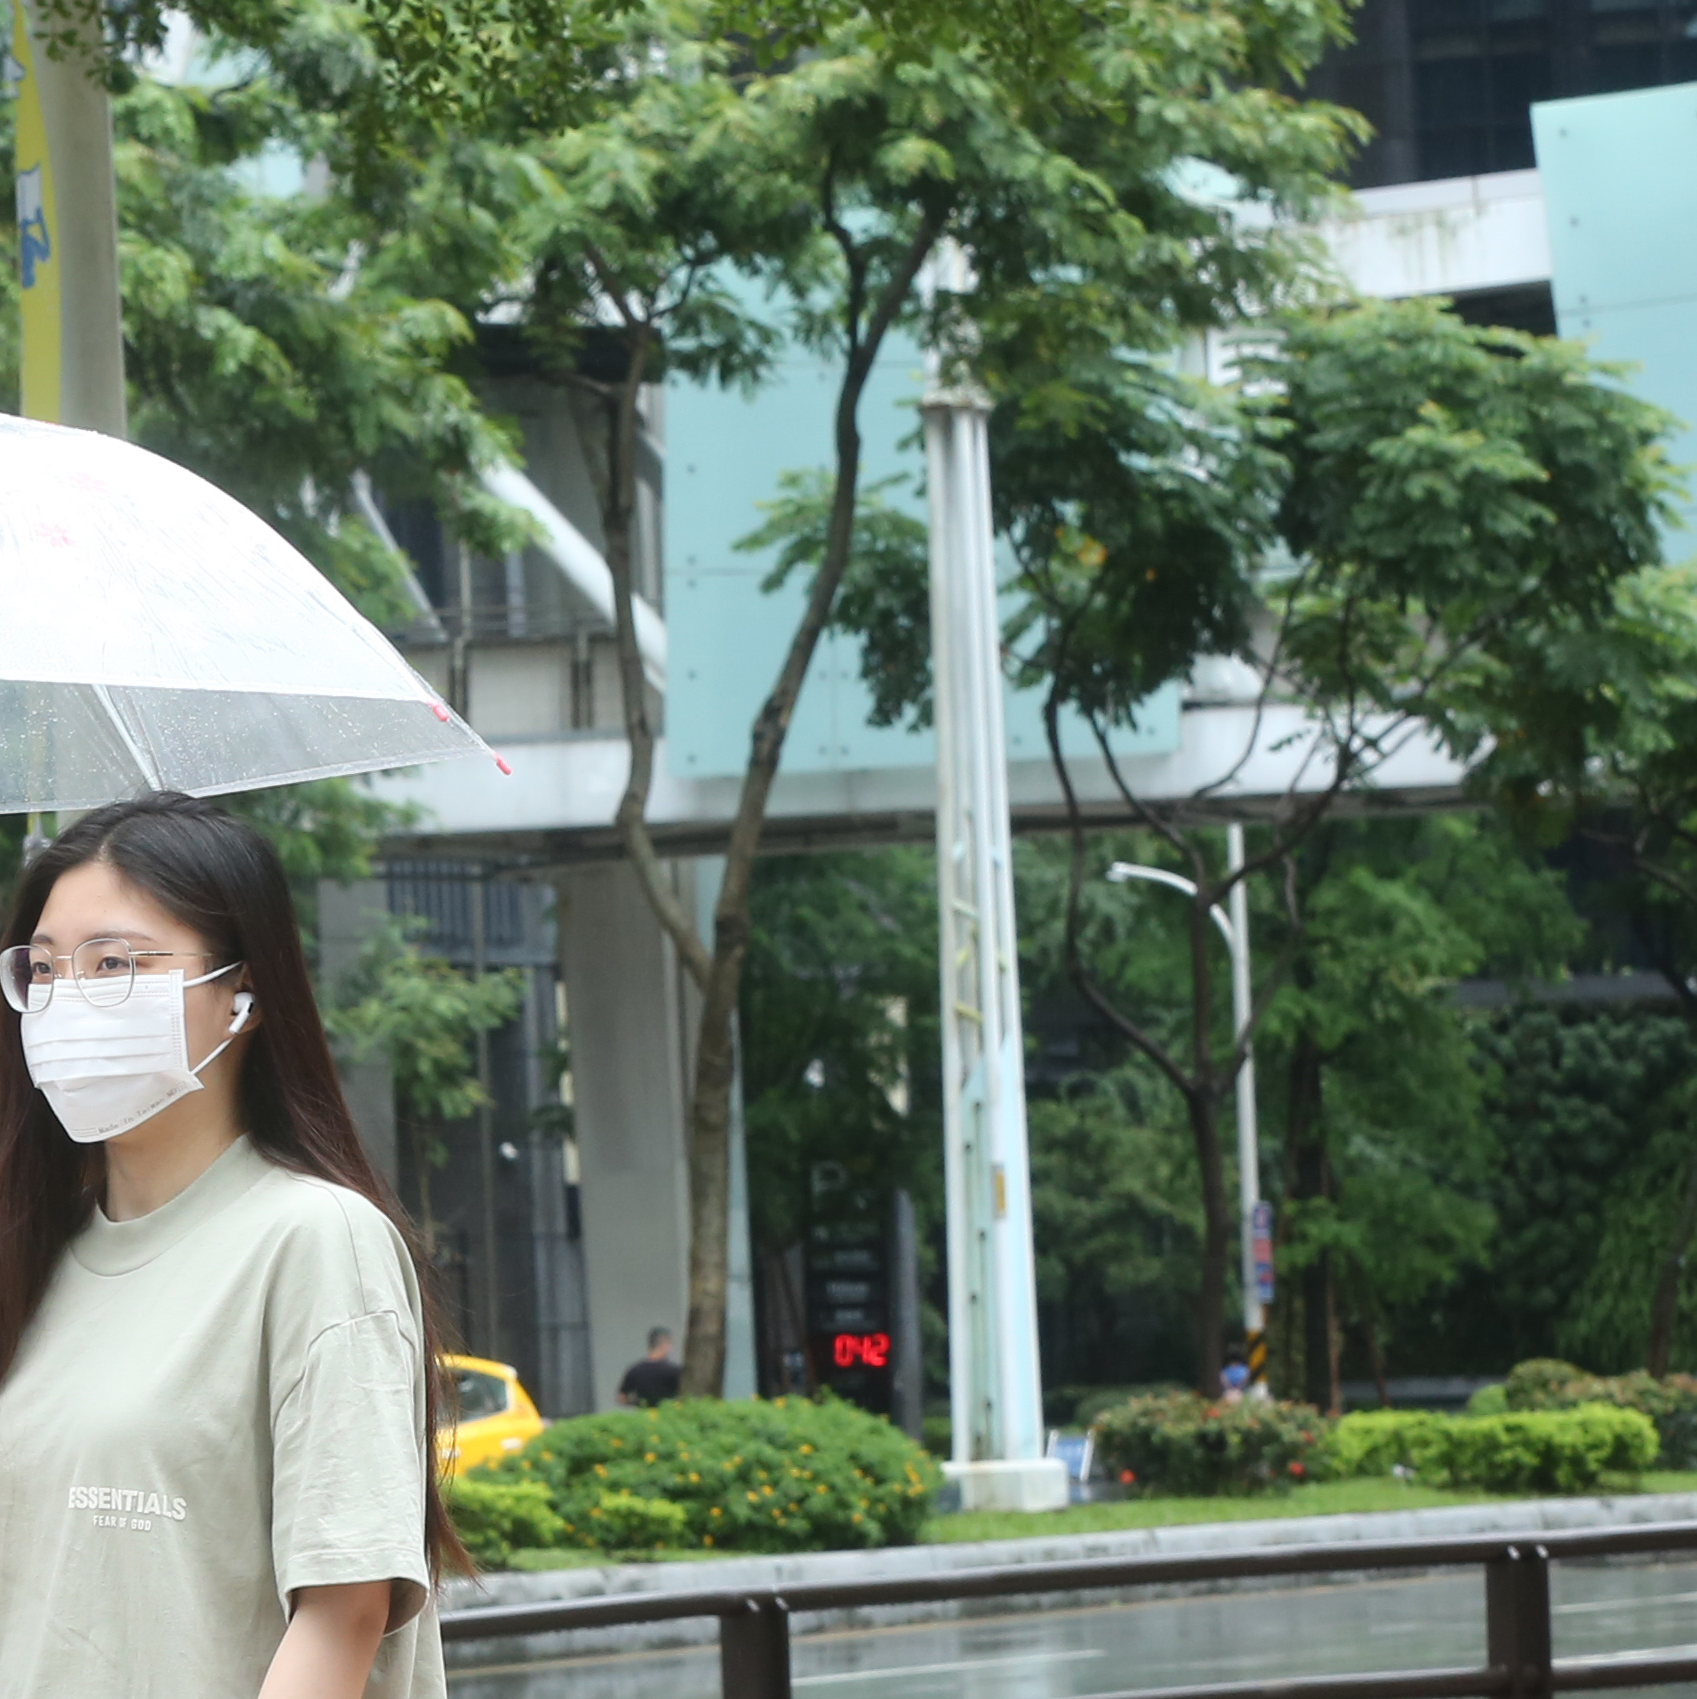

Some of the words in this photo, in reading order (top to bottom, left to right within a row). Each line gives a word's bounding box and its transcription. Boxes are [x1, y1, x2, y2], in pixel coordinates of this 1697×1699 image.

[834, 1332, 890, 1367] 042
[67, 1486, 188, 1521] ESSENTIALS
[92, 1514, 117, 1527] FEAR
[130, 1518, 153, 1532] GOD
